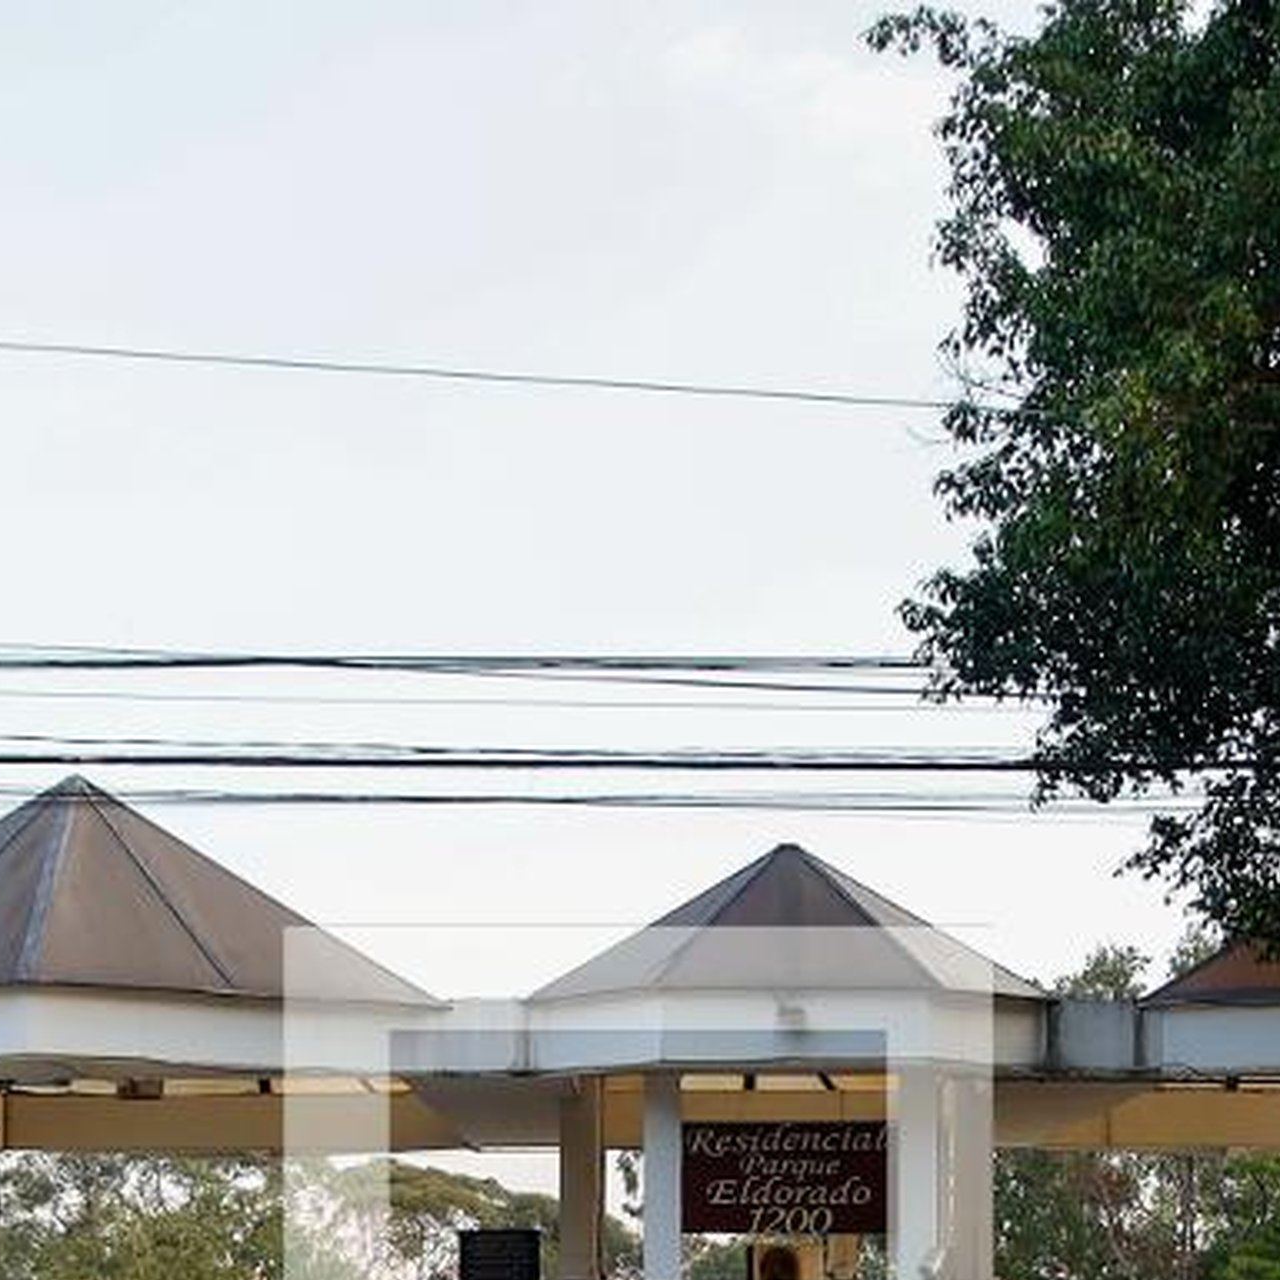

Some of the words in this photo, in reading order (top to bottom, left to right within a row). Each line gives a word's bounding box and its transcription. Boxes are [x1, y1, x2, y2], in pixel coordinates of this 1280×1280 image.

[689, 1124, 892, 1157] Residencial
[739, 1153, 841, 1181] Parque
[706, 1175, 870, 1205] Eldorado
[750, 1207, 833, 1235] 1200
